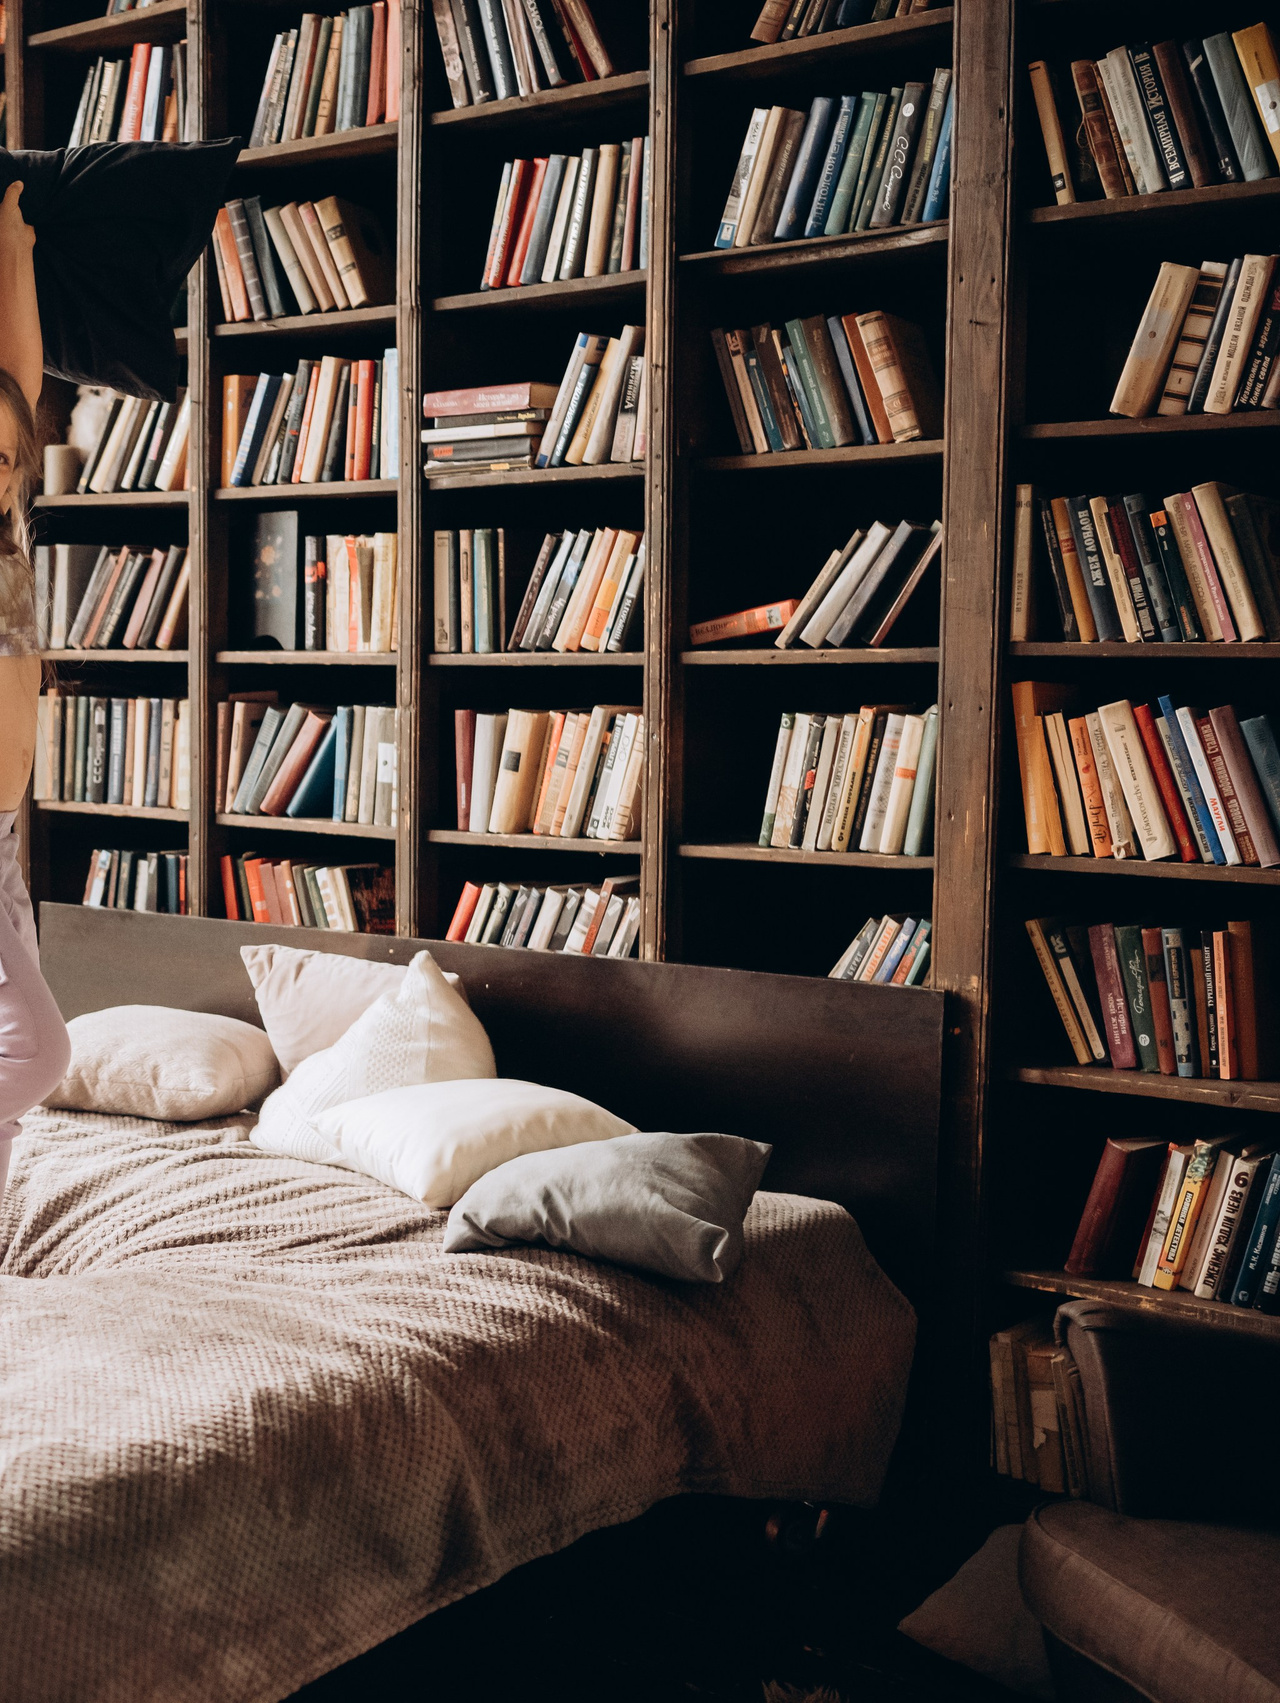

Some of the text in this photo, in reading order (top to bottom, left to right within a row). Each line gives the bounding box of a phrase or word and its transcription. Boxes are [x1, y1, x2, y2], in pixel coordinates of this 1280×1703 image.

[1152, 110, 1180, 171] ВСЕМИРНАЯ
[1240, 274, 1254, 303] ОДЕЖДЫ
[1232, 304, 1246, 331] ВЯЗАНОЙ
[1226, 333, 1239, 358] МОДЕЛИ
[1239, 357, 1261, 404] Незнакомец
[1257, 317, 1273, 349] зеркале
[1248, 355, 1270, 406] Конец света
[1076, 508, 1106, 588] ДЖЕК ЛОНДОН
[1199, 723, 1219, 755] Сталина
[1210, 754, 1234, 798] любовницы
[1186, 796, 1203, 832] ПОТИЕВСКИЙ
[1224, 797, 1247, 834] Исповедь
[1198, 832, 1210, 853] ВИКТОР
[1203, 945, 1211, 971] ГАМБИТ
[1204, 972, 1213, 1006] ТУРЕЦКИЙ
[1114, 997, 1128, 1035] История
[1178, 1191, 1193, 1224] НОВИНКИ
[1167, 1222, 1184, 1261] ДЕТЕКТИВА
[1201, 1169, 1250, 1290] ДЖЕЙМС ХЭДЛИ ЧЕЙЗ 6
[1252, 1223, 1268, 1254] Касвинов
